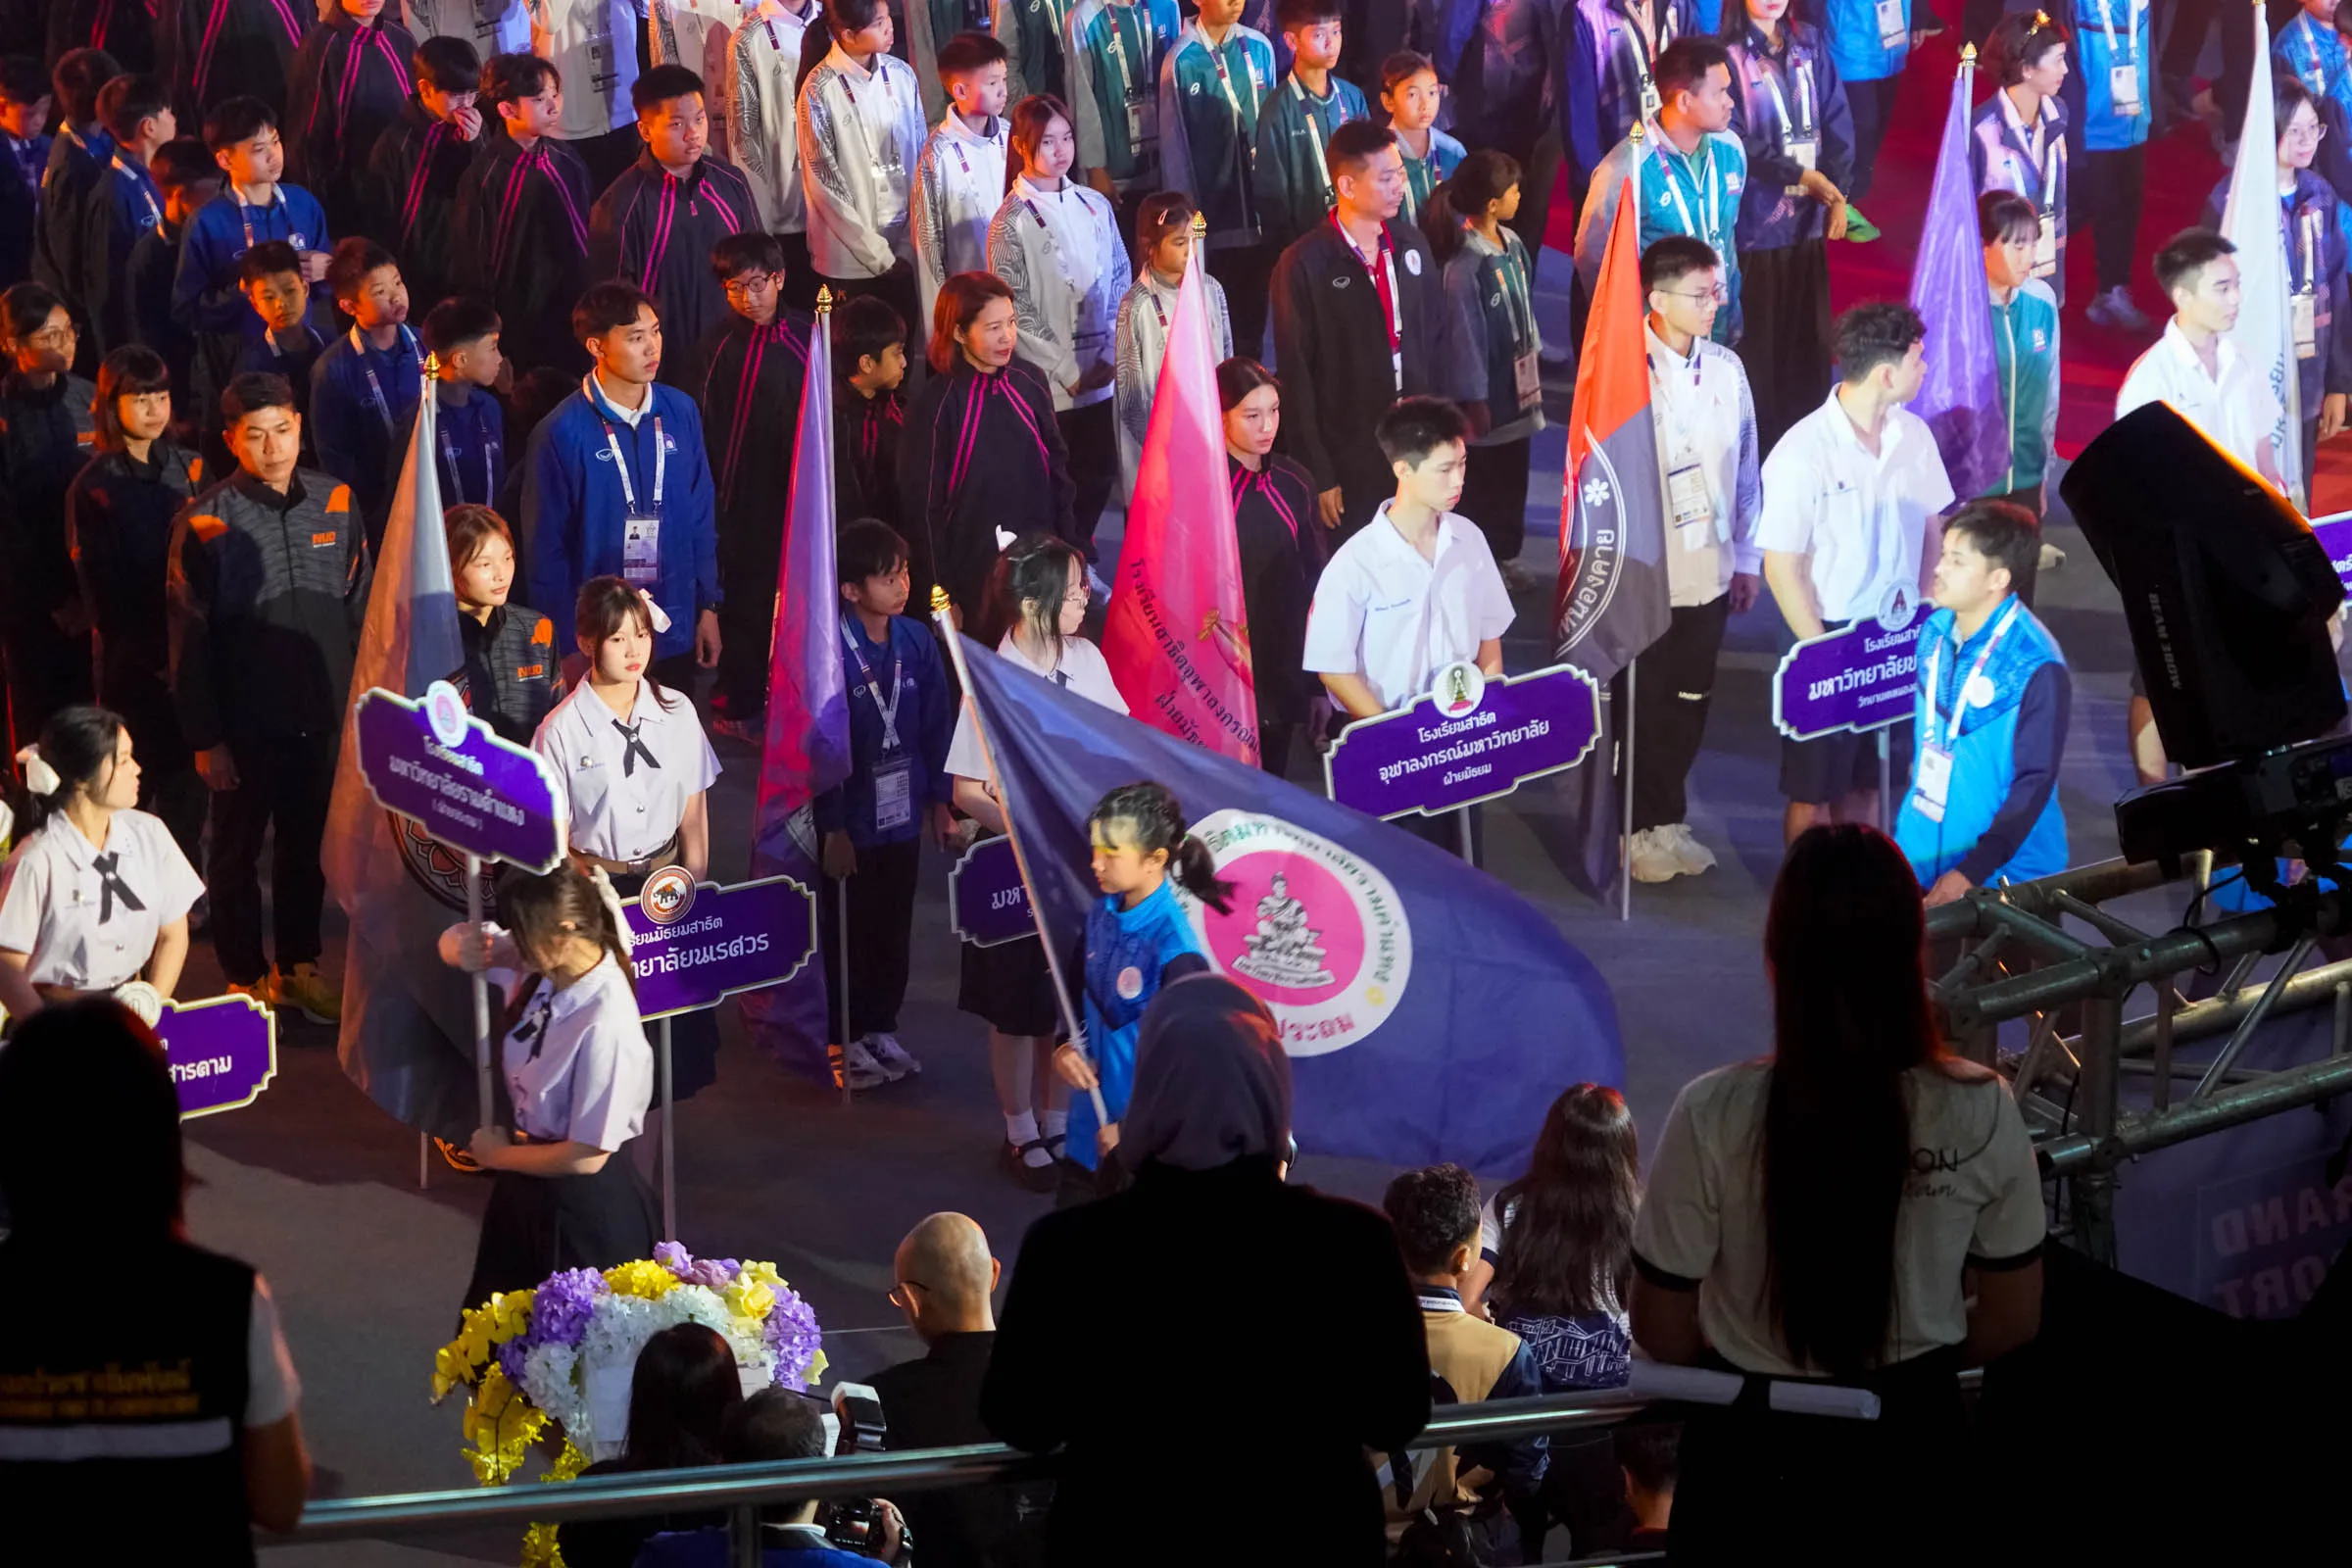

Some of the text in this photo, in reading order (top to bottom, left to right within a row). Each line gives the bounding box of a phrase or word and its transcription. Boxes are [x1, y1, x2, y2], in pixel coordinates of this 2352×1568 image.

[2148, 593, 2170, 639] BEAM
[1864, 624, 1921, 654] โรงเรียนสา
[1417, 710, 1496, 744] โรงเรียนสาธิต
[1378, 718, 1550, 785] จุฬาลงกรณ์มหาวิทยาลัย
[1443, 762, 1493, 786] ฝ่ายมัธยม
